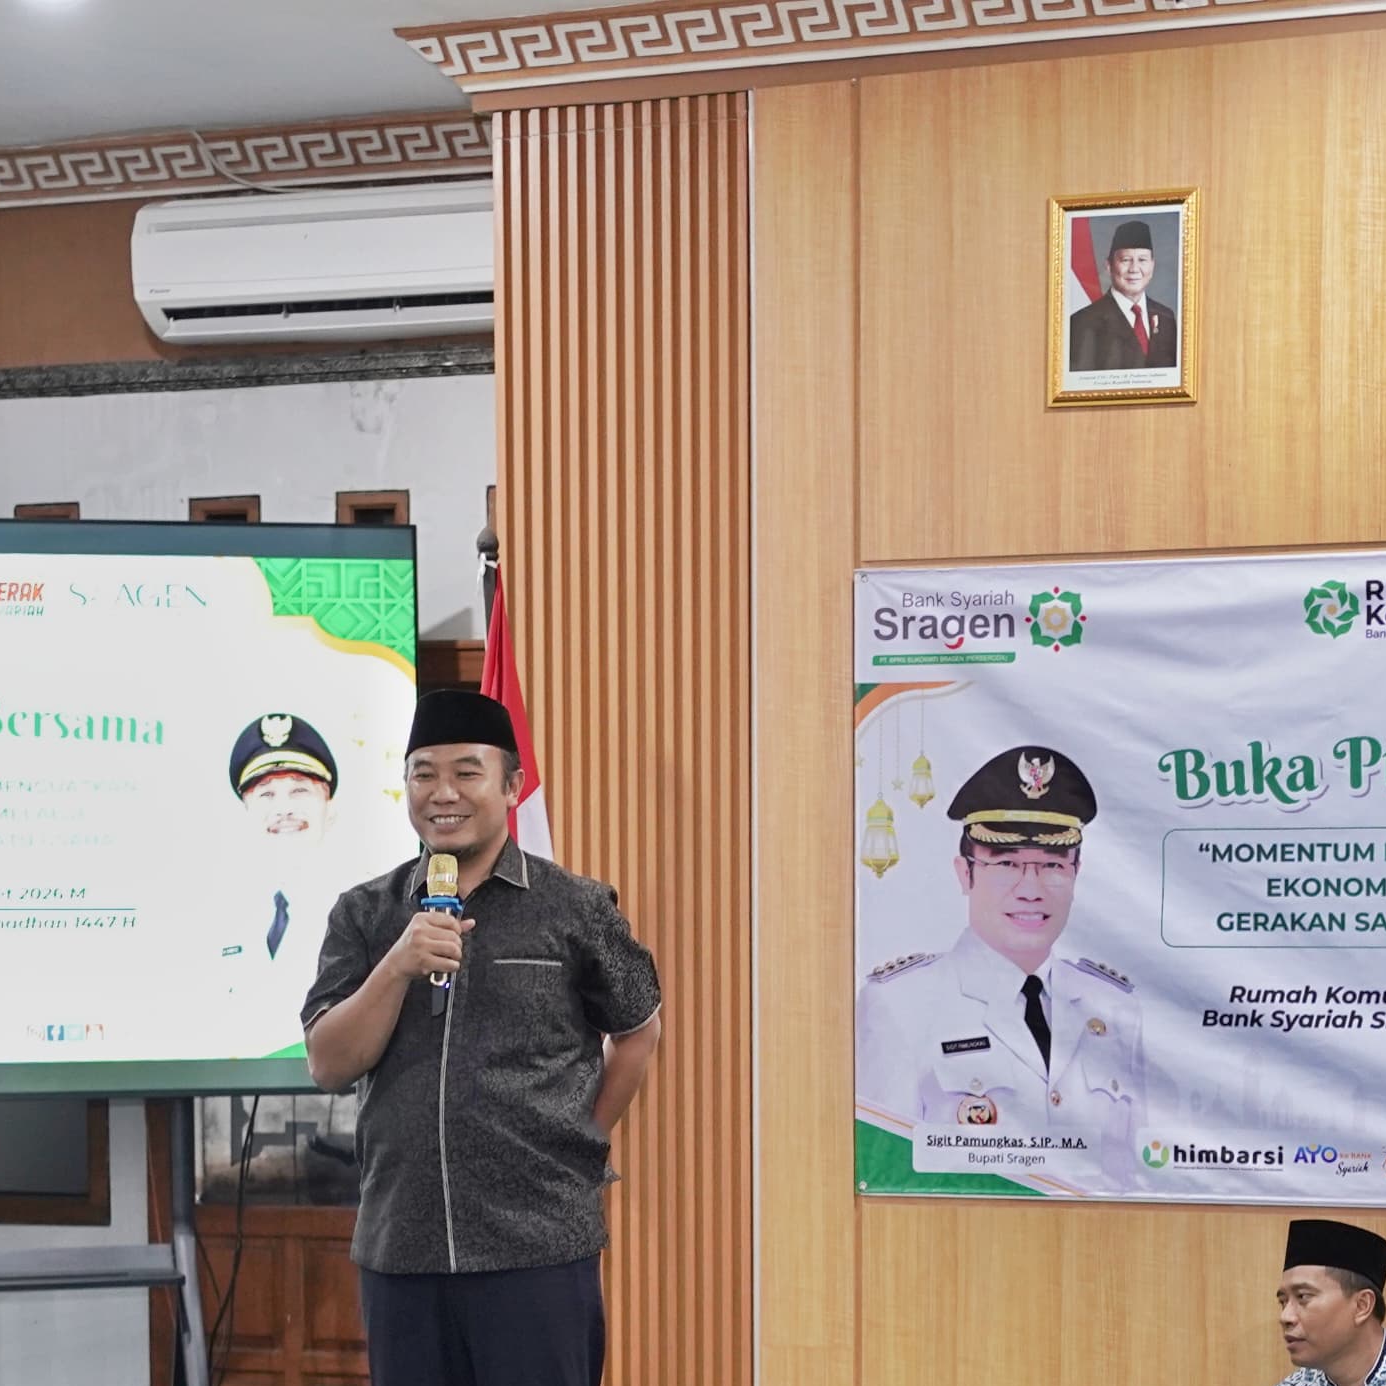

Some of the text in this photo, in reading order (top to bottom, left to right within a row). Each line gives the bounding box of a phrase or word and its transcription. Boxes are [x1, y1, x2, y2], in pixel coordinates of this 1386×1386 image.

[902, 590, 1015, 610] Bank Syariah
[873, 607, 1016, 649] Sragen
[1158, 741, 1318, 804] Buka
[1198, 842, 1375, 864] “MOMENTUM
[70, 888, 85, 900] M
[122, 916, 136, 928] H
[1215, 912, 1346, 933] GERAKAN
[1229, 985, 1318, 1005] Rumah
[1202, 1009, 1264, 1029] Bank
[1270, 1009, 1364, 1032] Syariah
[926, 1135, 952, 1150] Sigit
[968, 1153, 1046, 1167] Bupati Sragen
[1174, 1144, 1284, 1165] himbarsi
[1293, 1144, 1338, 1164] AYO
